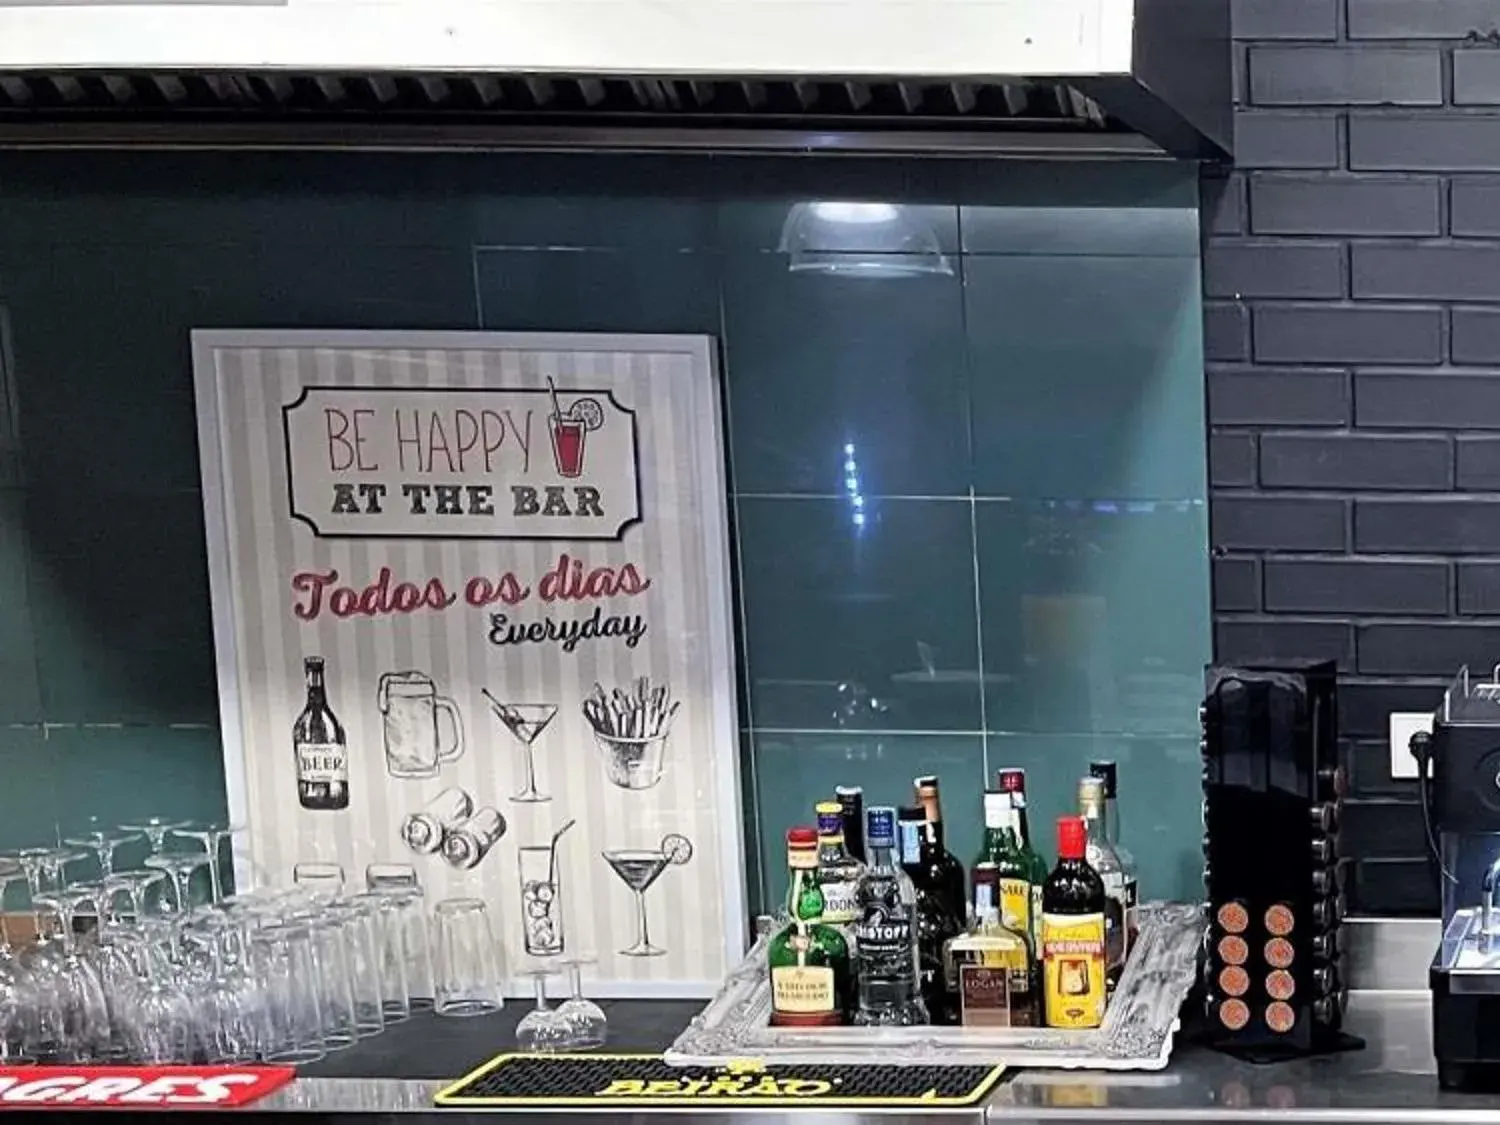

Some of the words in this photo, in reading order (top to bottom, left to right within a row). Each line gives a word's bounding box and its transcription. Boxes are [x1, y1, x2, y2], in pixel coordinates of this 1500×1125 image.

[325, 408, 378, 472] BE
[395, 409, 533, 473] HAPPY
[331, 484, 387, 514] AT
[402, 485, 495, 516] THE
[511, 486, 604, 516] BAR
[293, 566, 456, 621] Todos
[465, 572, 531, 606] os
[538, 554, 651, 602] dias
[489, 606, 647, 652] Everyday
[302, 755, 342, 771] BEER
